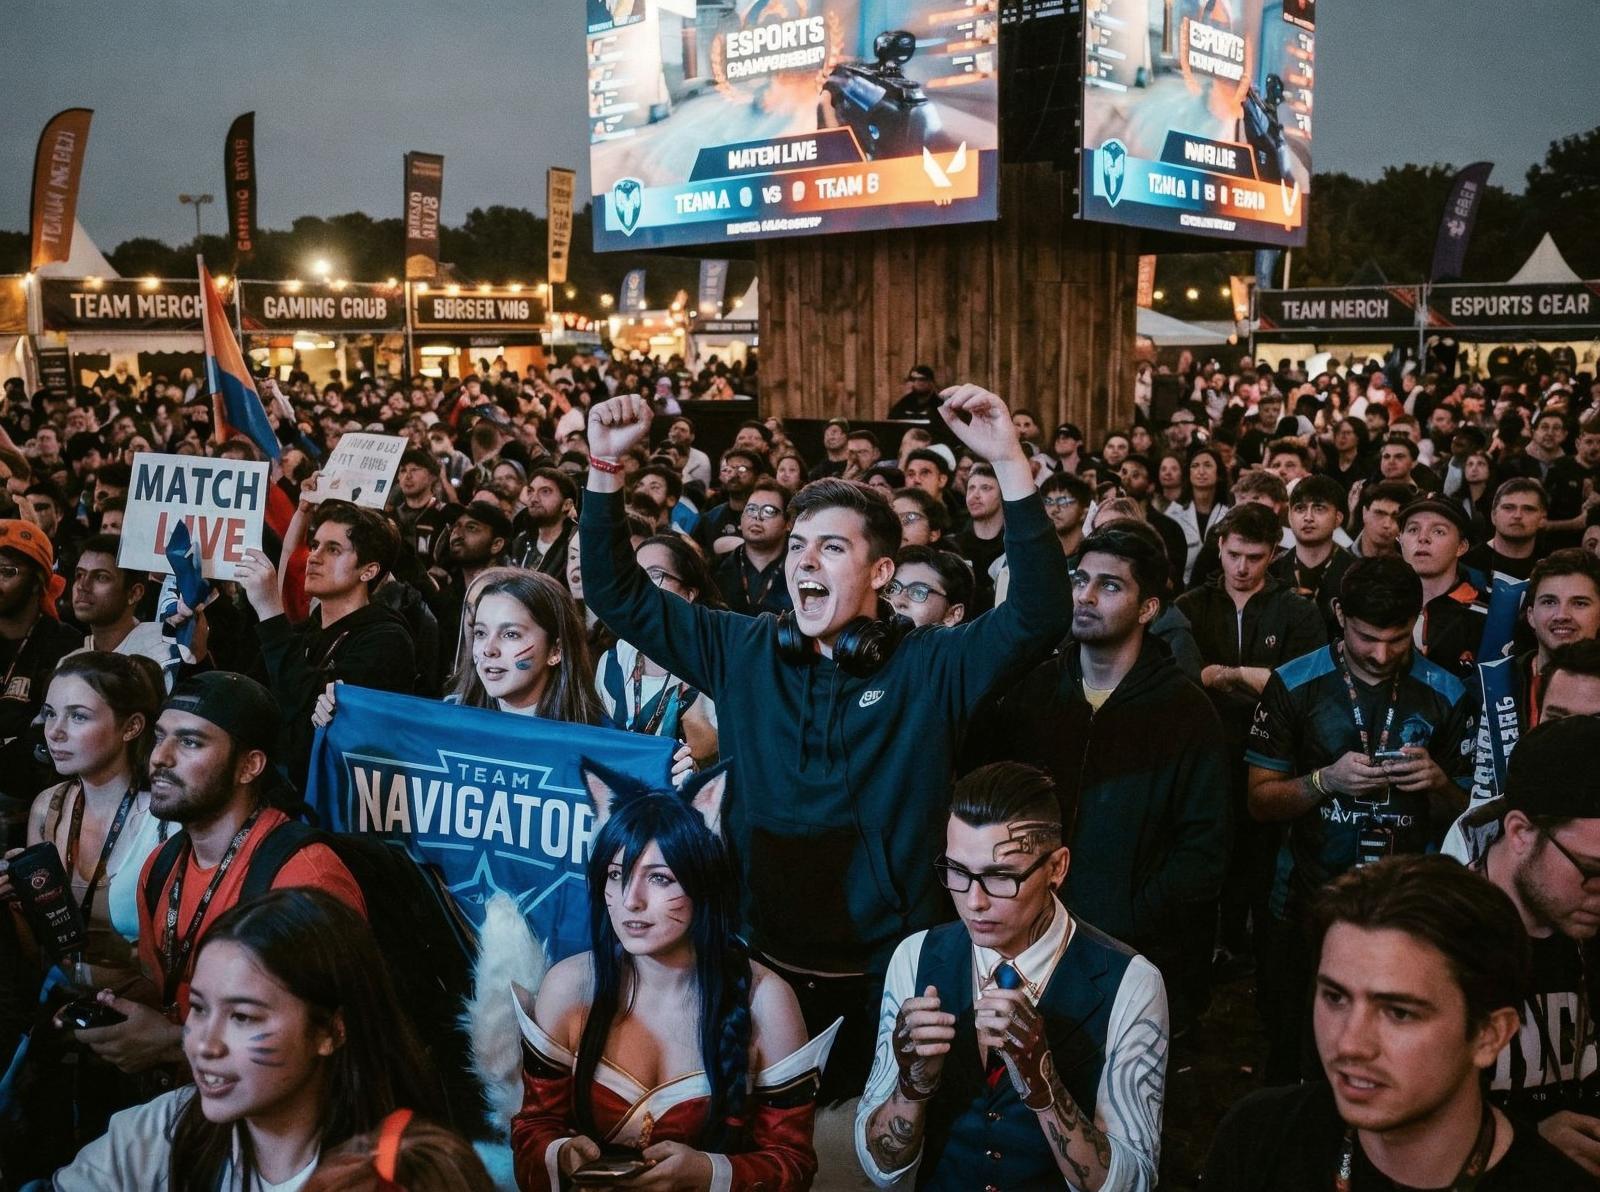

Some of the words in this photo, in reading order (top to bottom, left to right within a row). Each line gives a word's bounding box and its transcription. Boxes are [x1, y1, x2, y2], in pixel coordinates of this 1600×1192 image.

[726, 15, 825, 59] ESPORTS
[782, 140, 818, 164] LIVE
[674, 191, 717, 214] TEAM
[717, 189, 731, 209] A
[816, 175, 863, 200] TEAM
[70, 293, 131, 319] TEAM
[263, 296, 336, 319] GAMING
[1281, 300, 1326, 320] TEAM
[134, 463, 260, 511] MATCH
[457, 762, 530, 790] TEAM
